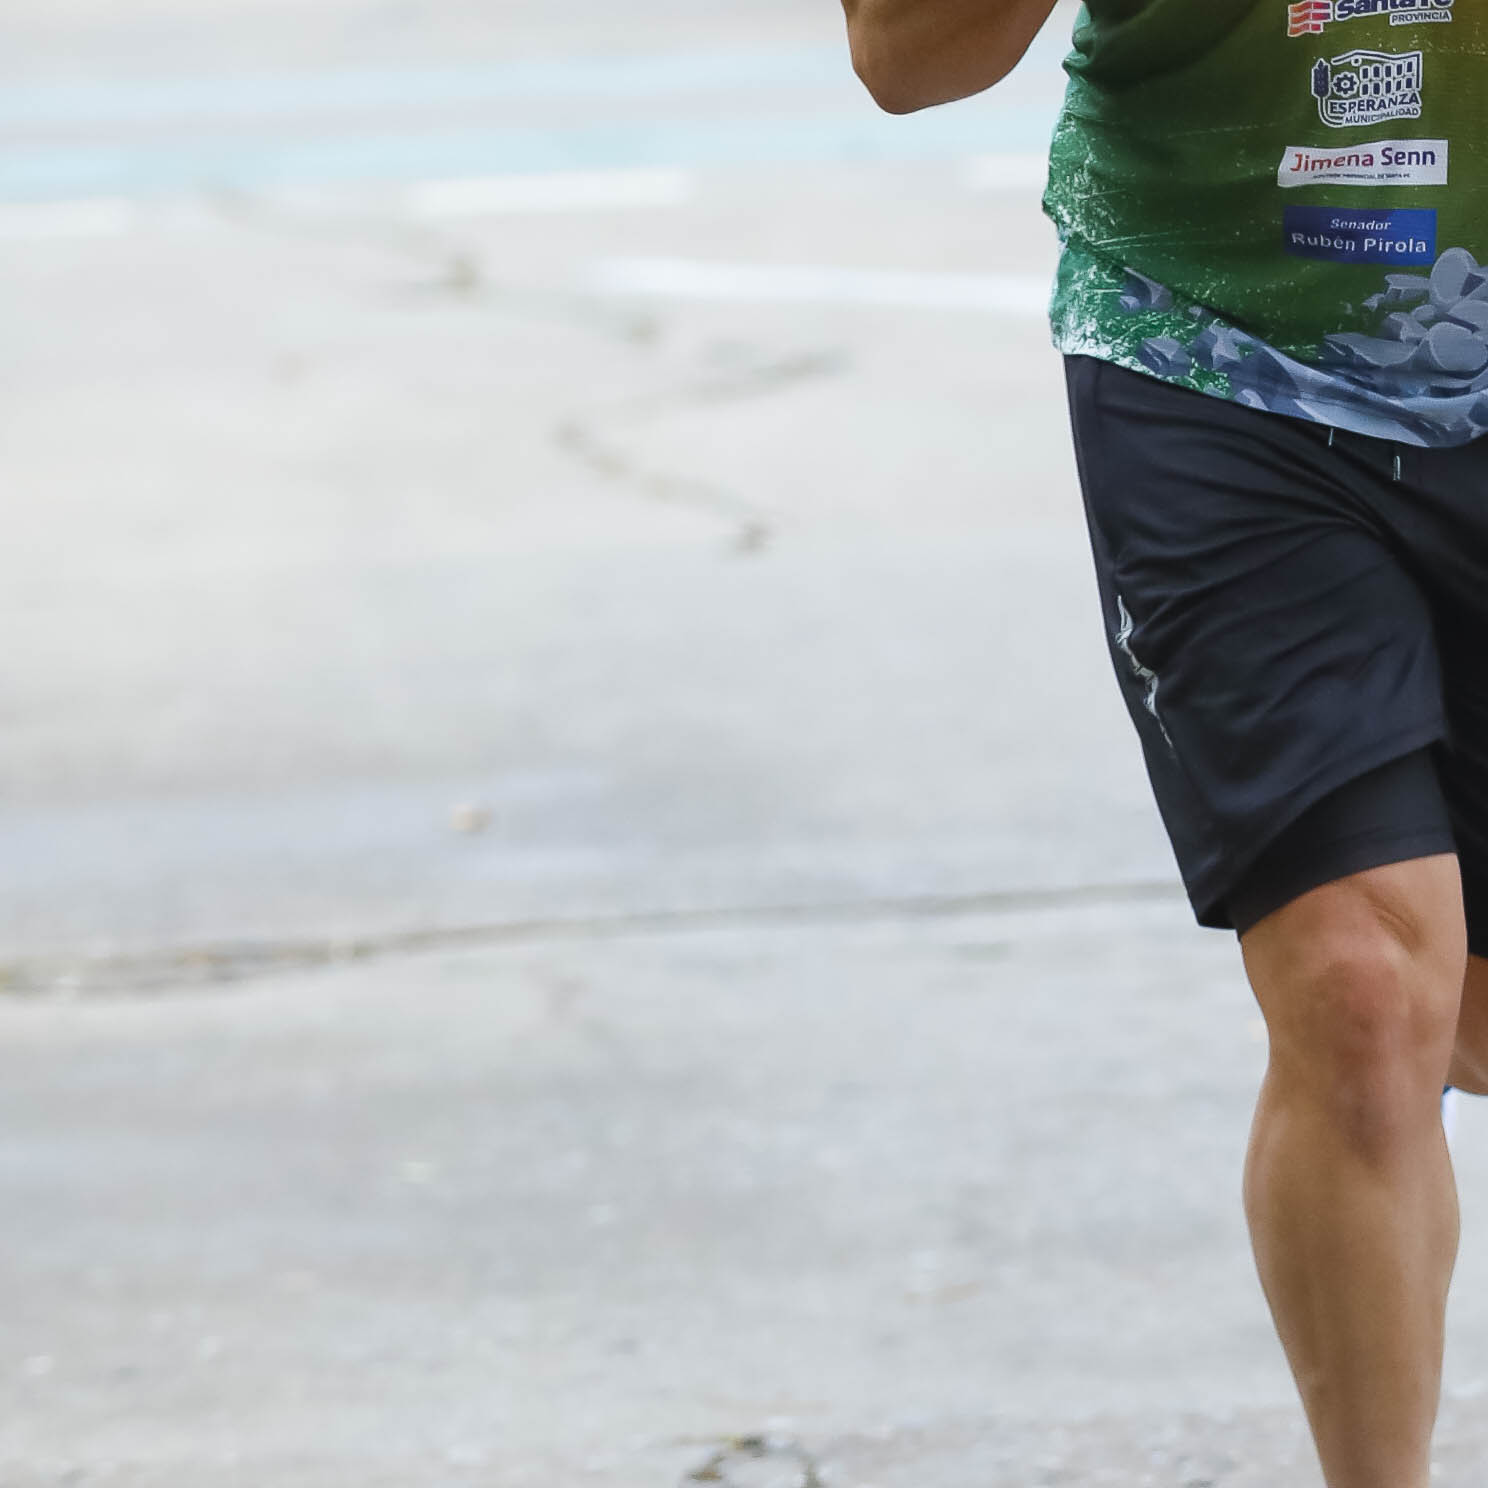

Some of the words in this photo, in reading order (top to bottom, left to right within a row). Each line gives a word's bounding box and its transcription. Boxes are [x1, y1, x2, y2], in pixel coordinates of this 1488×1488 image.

[1391, 11, 1451, 24] PROVINCIA
[1329, 93, 1420, 115] ESPERANZA
[1344, 107, 1420, 125] MUNICIPALIDAD
[1290, 152, 1374, 172] Jimena
[1381, 147, 1436, 167] Senn
[1330, 218, 1392, 232] Senador
[1291, 232, 1356, 252] Rubén
[1363, 237, 1428, 254] Pirola
